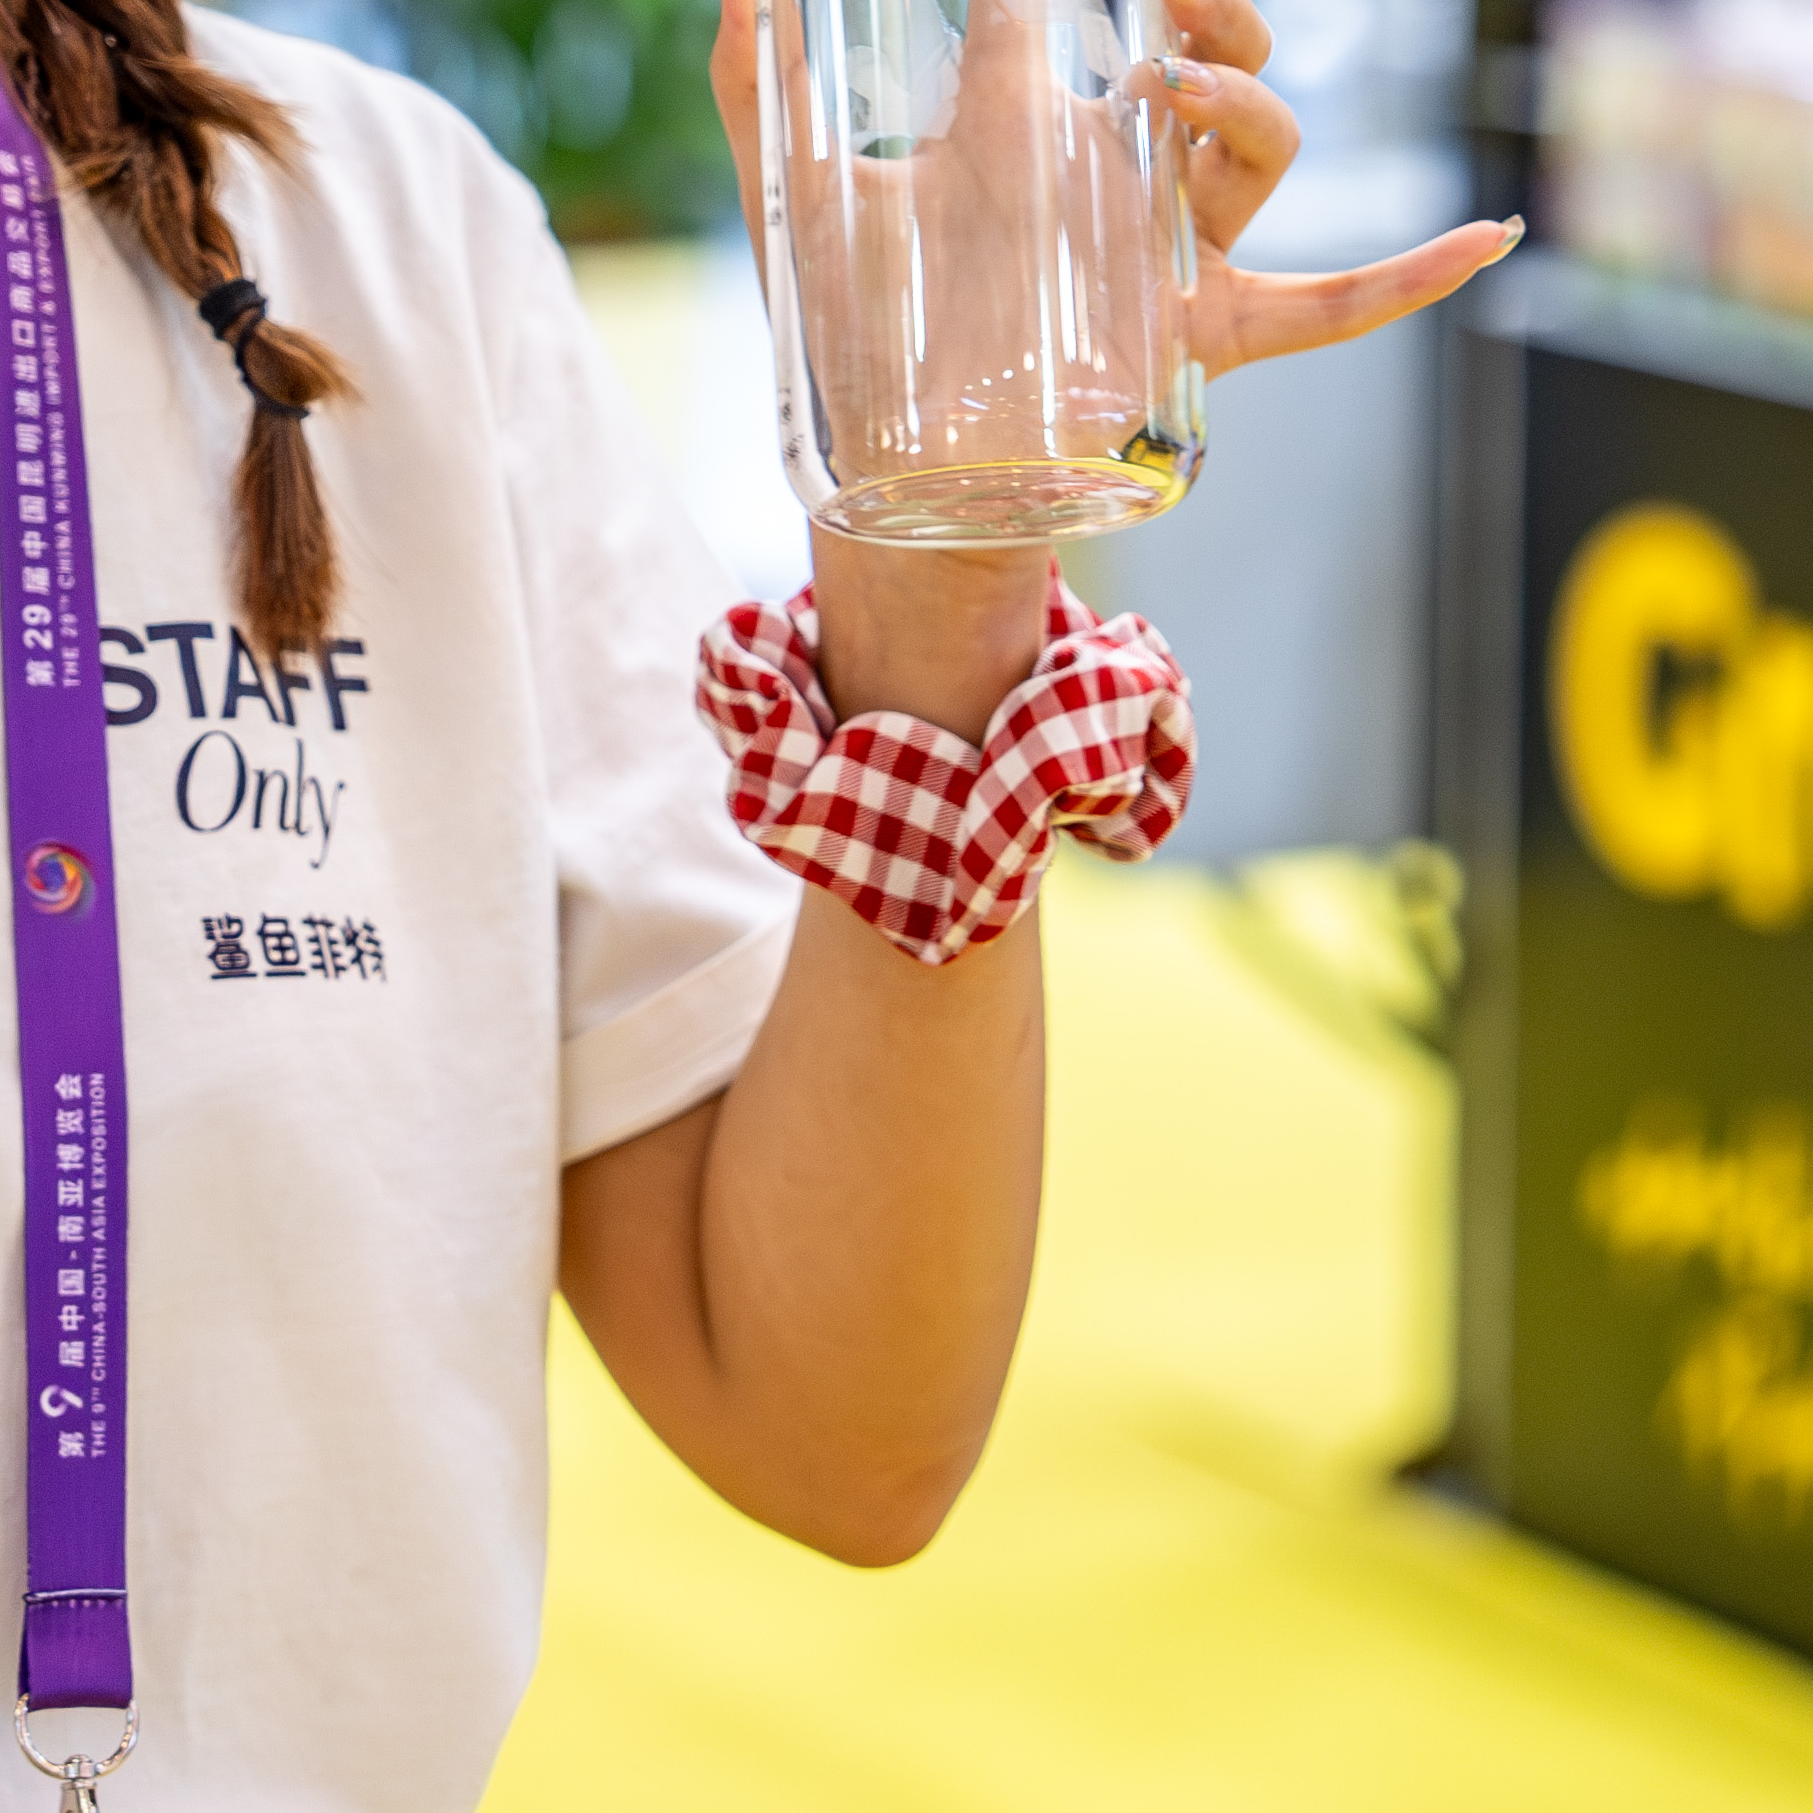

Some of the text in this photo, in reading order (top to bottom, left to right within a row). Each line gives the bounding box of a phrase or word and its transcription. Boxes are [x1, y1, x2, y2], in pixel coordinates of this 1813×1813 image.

[48, 412, 70, 515] KUNMING
[54, 520, 75, 590] CHINA
[61, 647, 80, 687] THE
[99, 620, 371, 732] STAFF
[174, 729, 346, 871] Only
[201, 912, 387, 983] 鲨鱼菲特
[90, 1073, 106, 1189] EXPOSITION
[91, 1196, 106, 1240] ASIA
[91, 1247, 106, 1381] CHINA-SOUTH
[91, 1422, 105, 1457] THE
